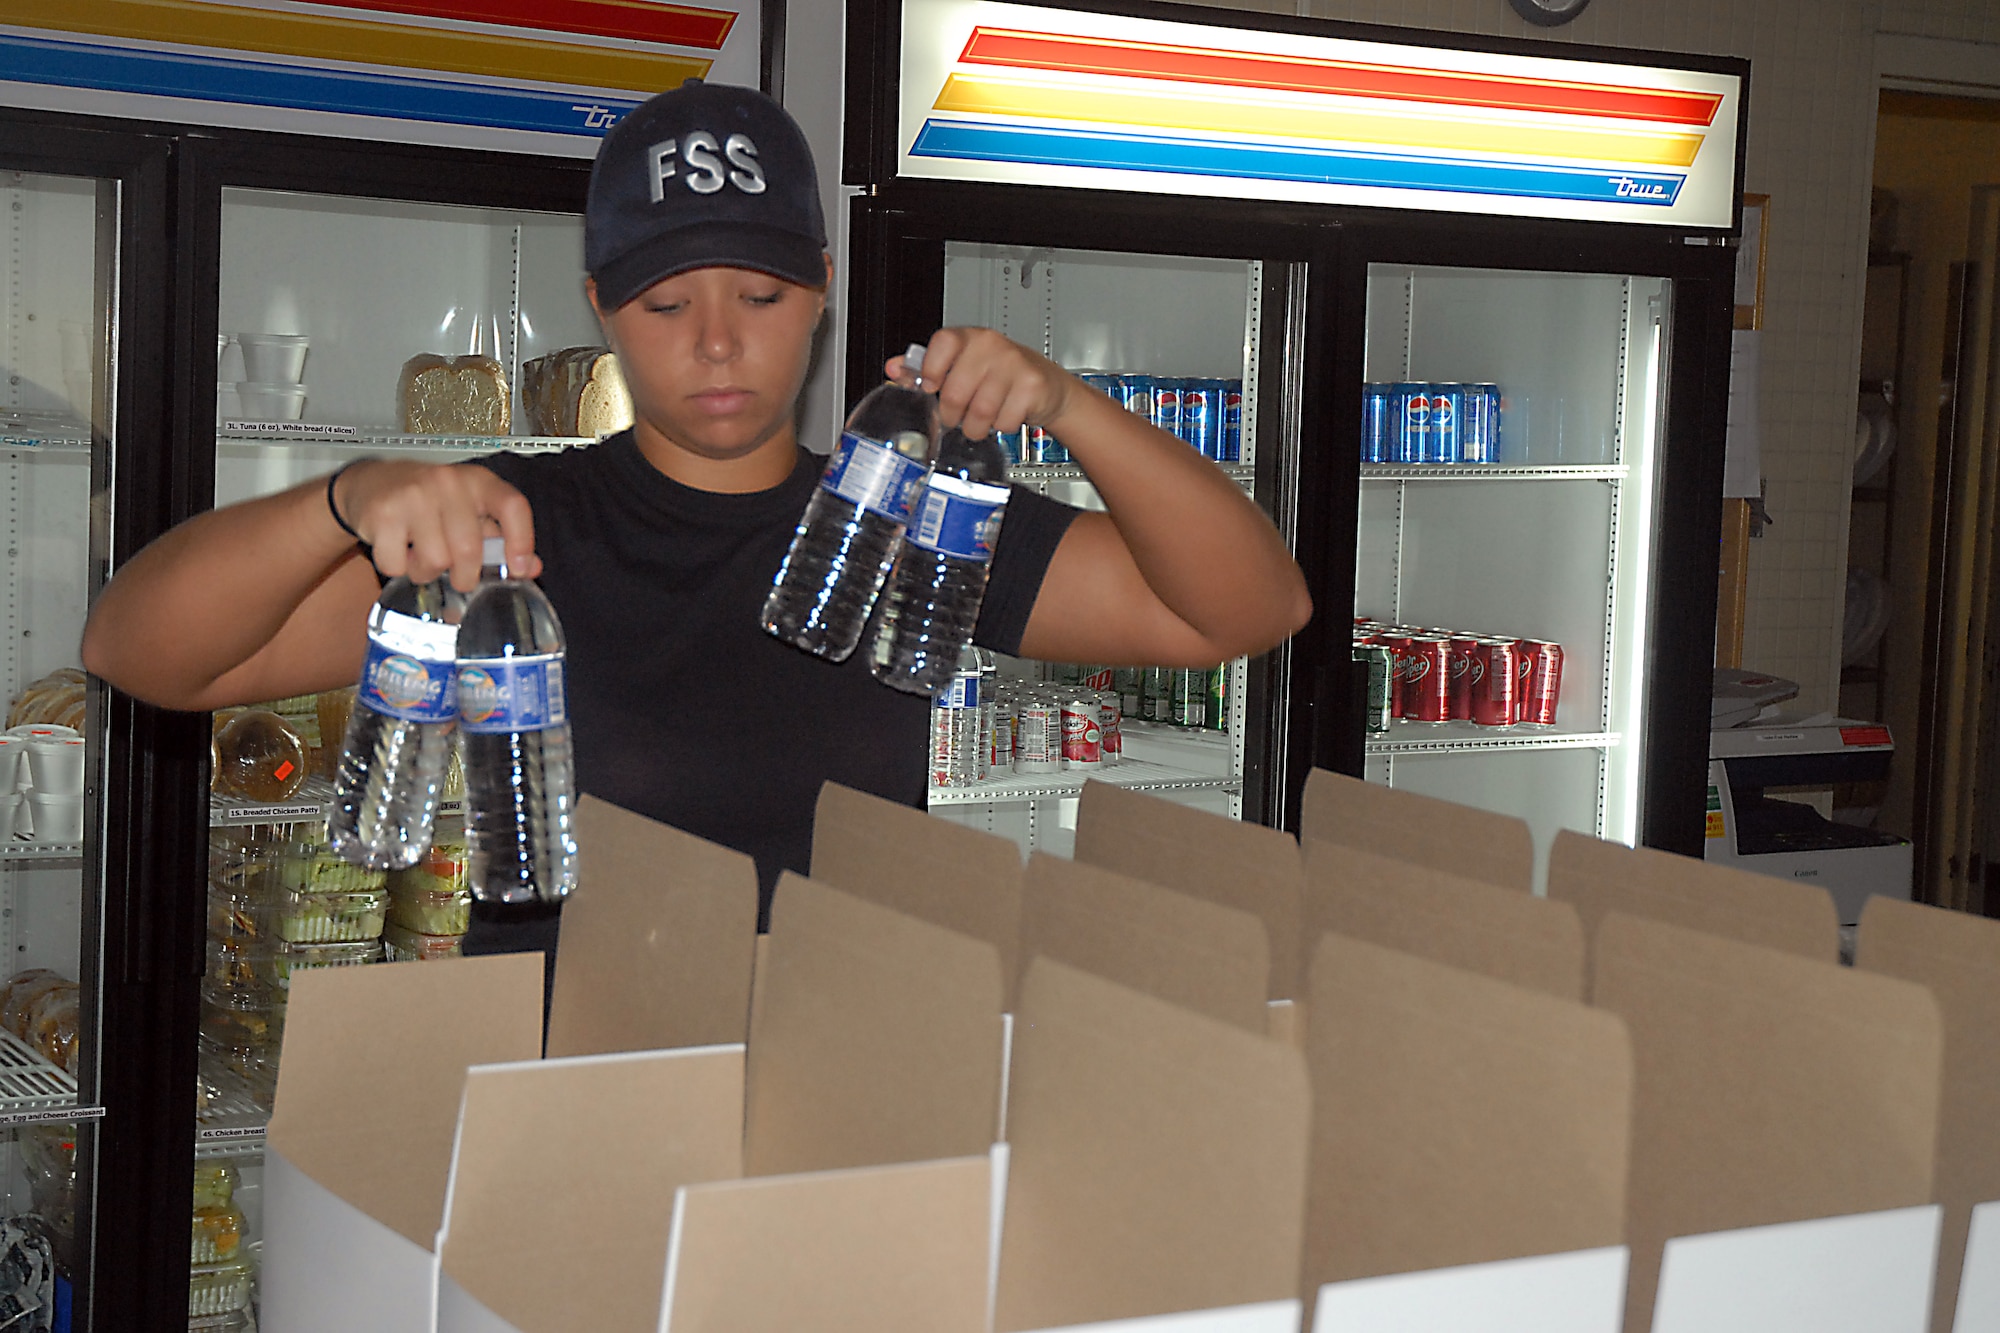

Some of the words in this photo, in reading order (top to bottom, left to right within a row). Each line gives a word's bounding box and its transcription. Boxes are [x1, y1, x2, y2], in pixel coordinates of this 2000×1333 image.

[572, 105, 626, 128] tr
[648, 129, 767, 203] FSS
[240, 423, 257, 431] Tuna
[282, 424, 302, 432] White
[304, 425, 323, 433] bread
[334, 427, 355, 436] slices)
[70, 1109, 104, 1117] Croissant
